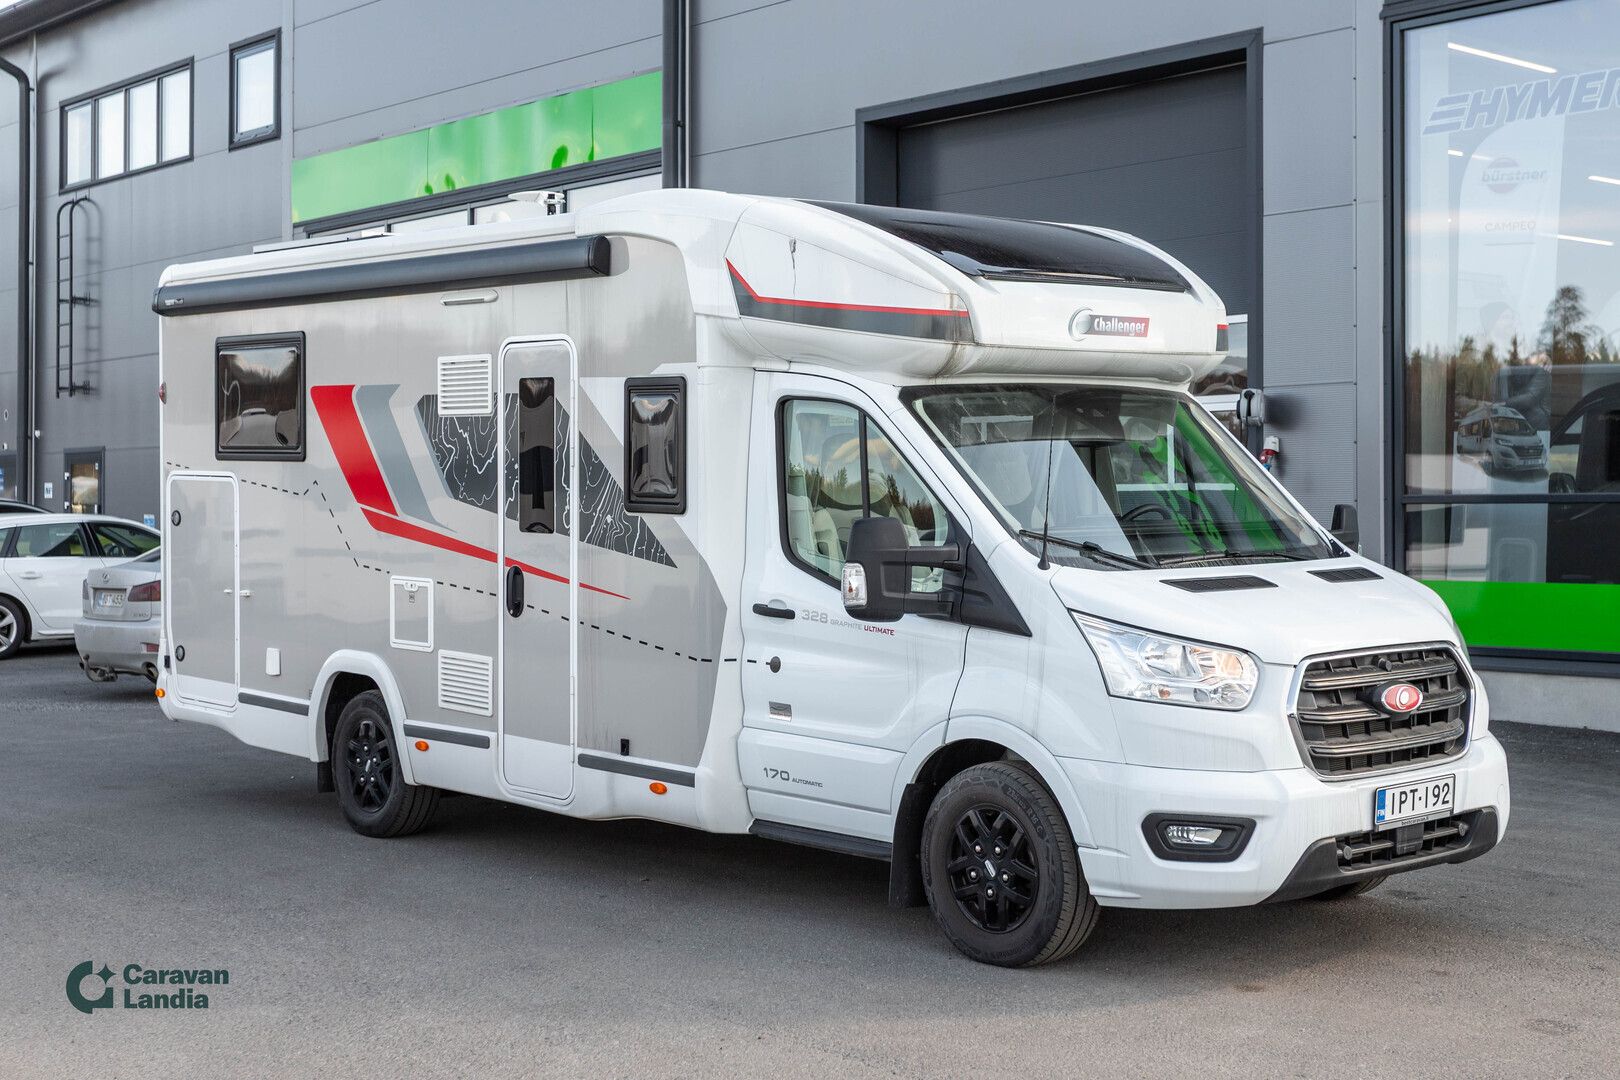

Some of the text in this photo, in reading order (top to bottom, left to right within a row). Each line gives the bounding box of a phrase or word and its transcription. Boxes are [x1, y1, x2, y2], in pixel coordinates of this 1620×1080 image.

[1095, 318, 1144, 336] Challenger
[802, 610, 895, 637] 328 GRAPHITE ULTIMATE
[763, 767, 823, 788] 170 AUTOMATIC
[1392, 783, 1450, 815] IPT-192
